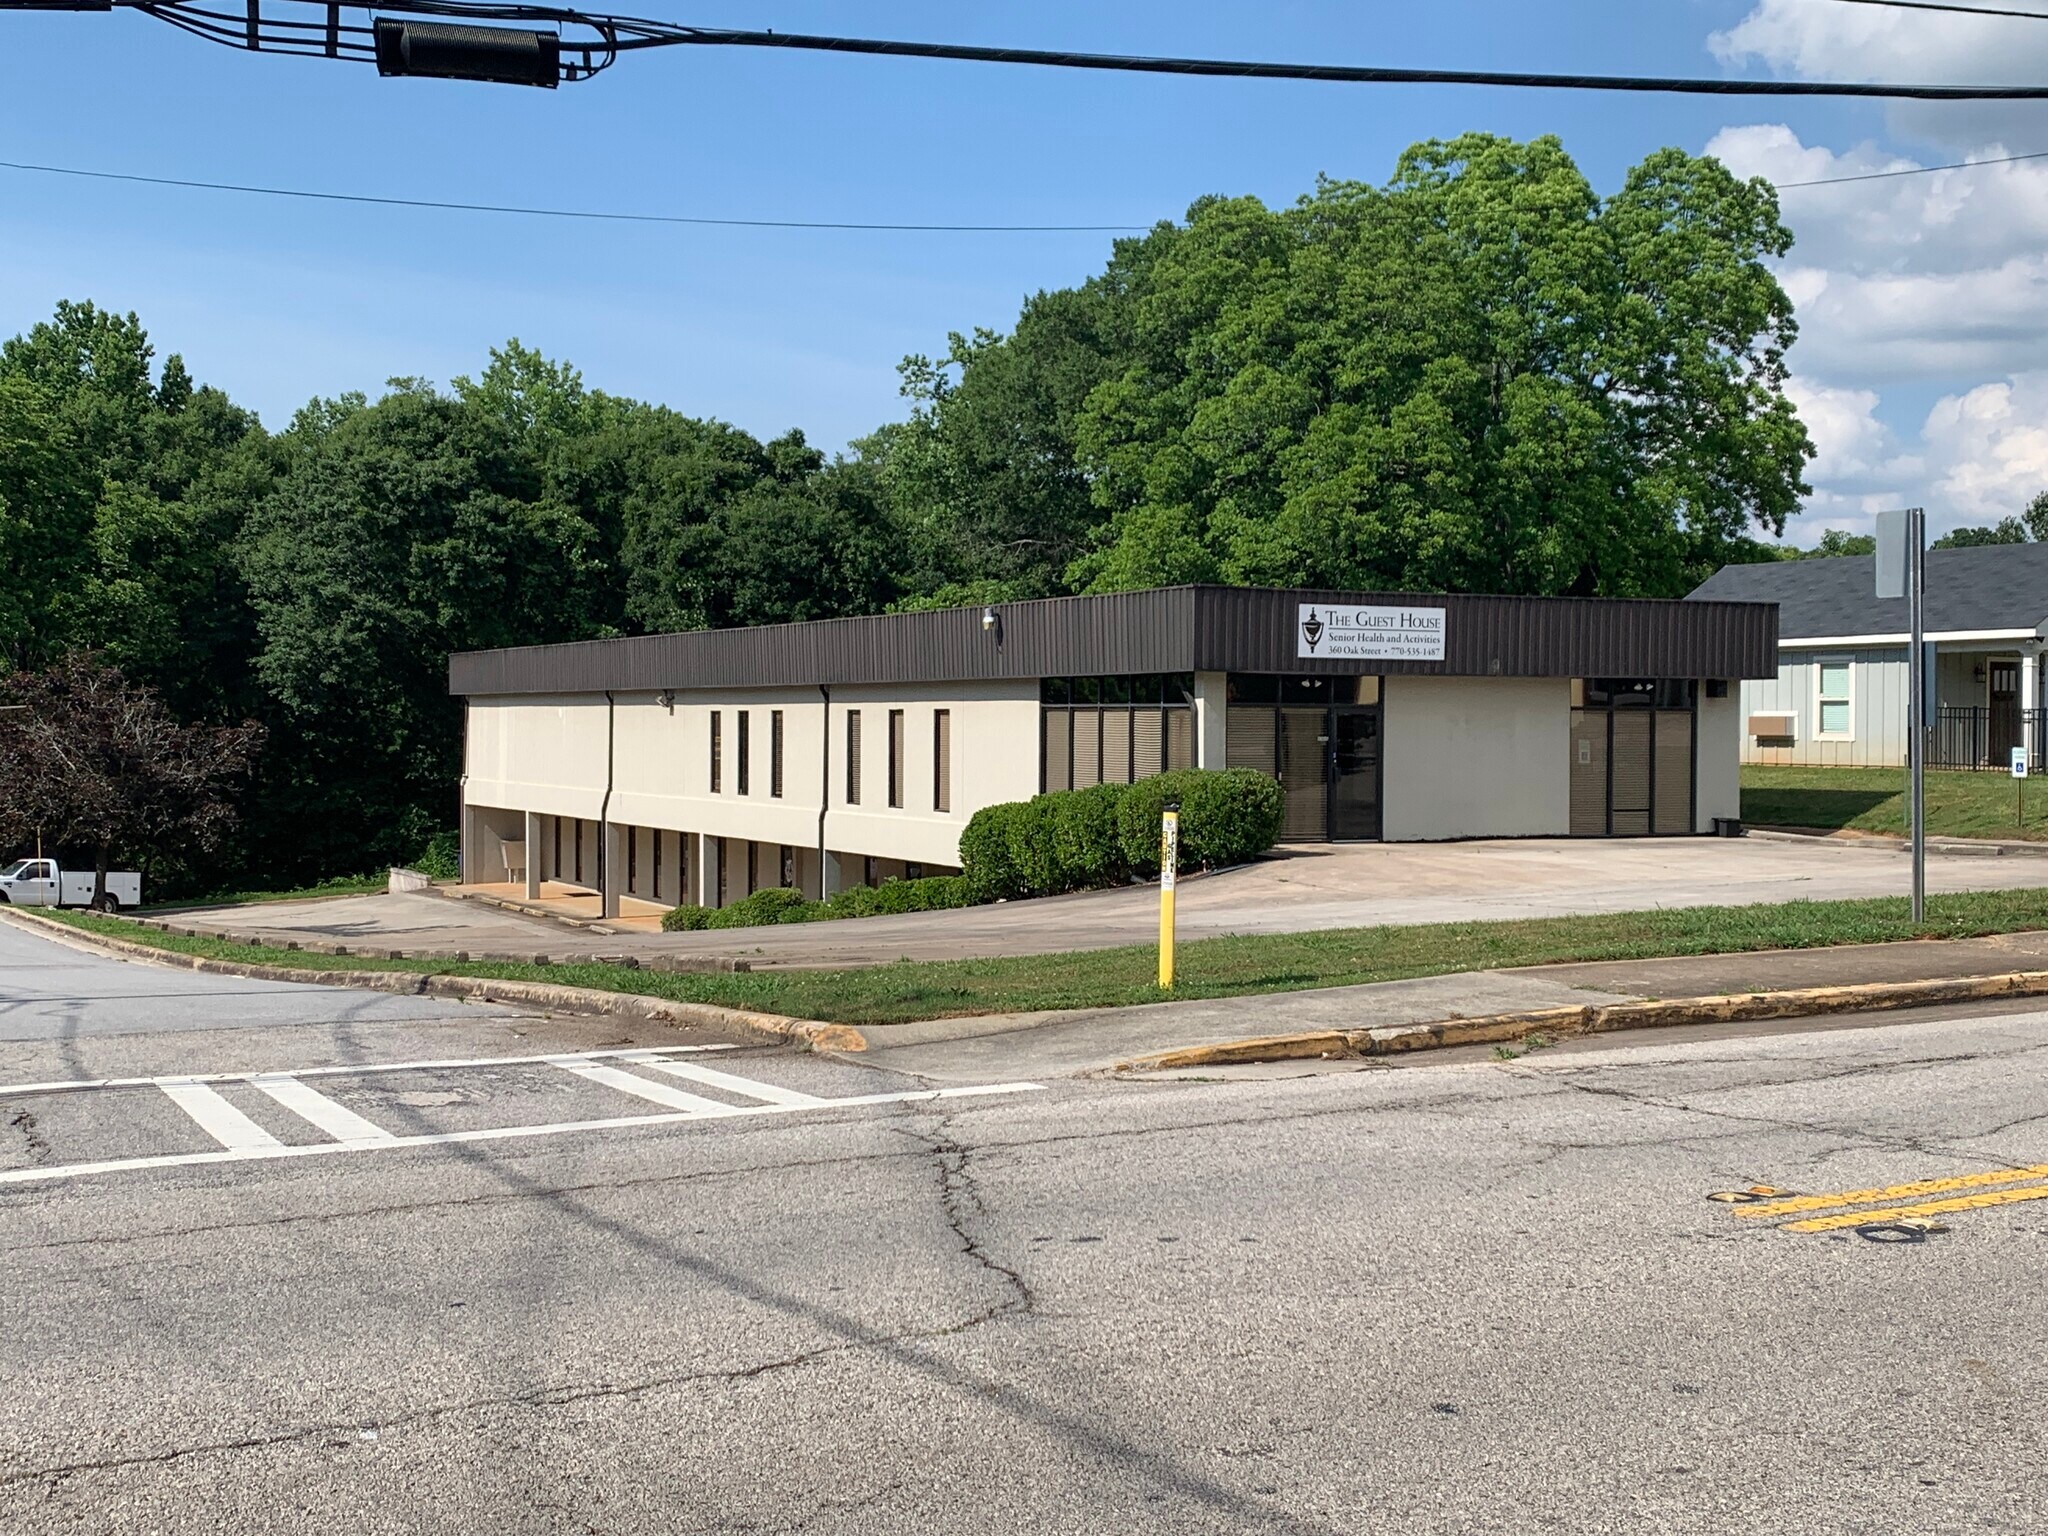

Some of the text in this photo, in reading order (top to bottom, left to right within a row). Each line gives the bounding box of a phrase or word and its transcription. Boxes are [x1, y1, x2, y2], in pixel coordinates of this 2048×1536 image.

[1325, 610, 1441, 629] THE GUEST HOUSE
[1328, 632, 1440, 644] Senior Health and Activities
[1328, 645, 1440, 656] 360 Oak Street 770-535-1487
